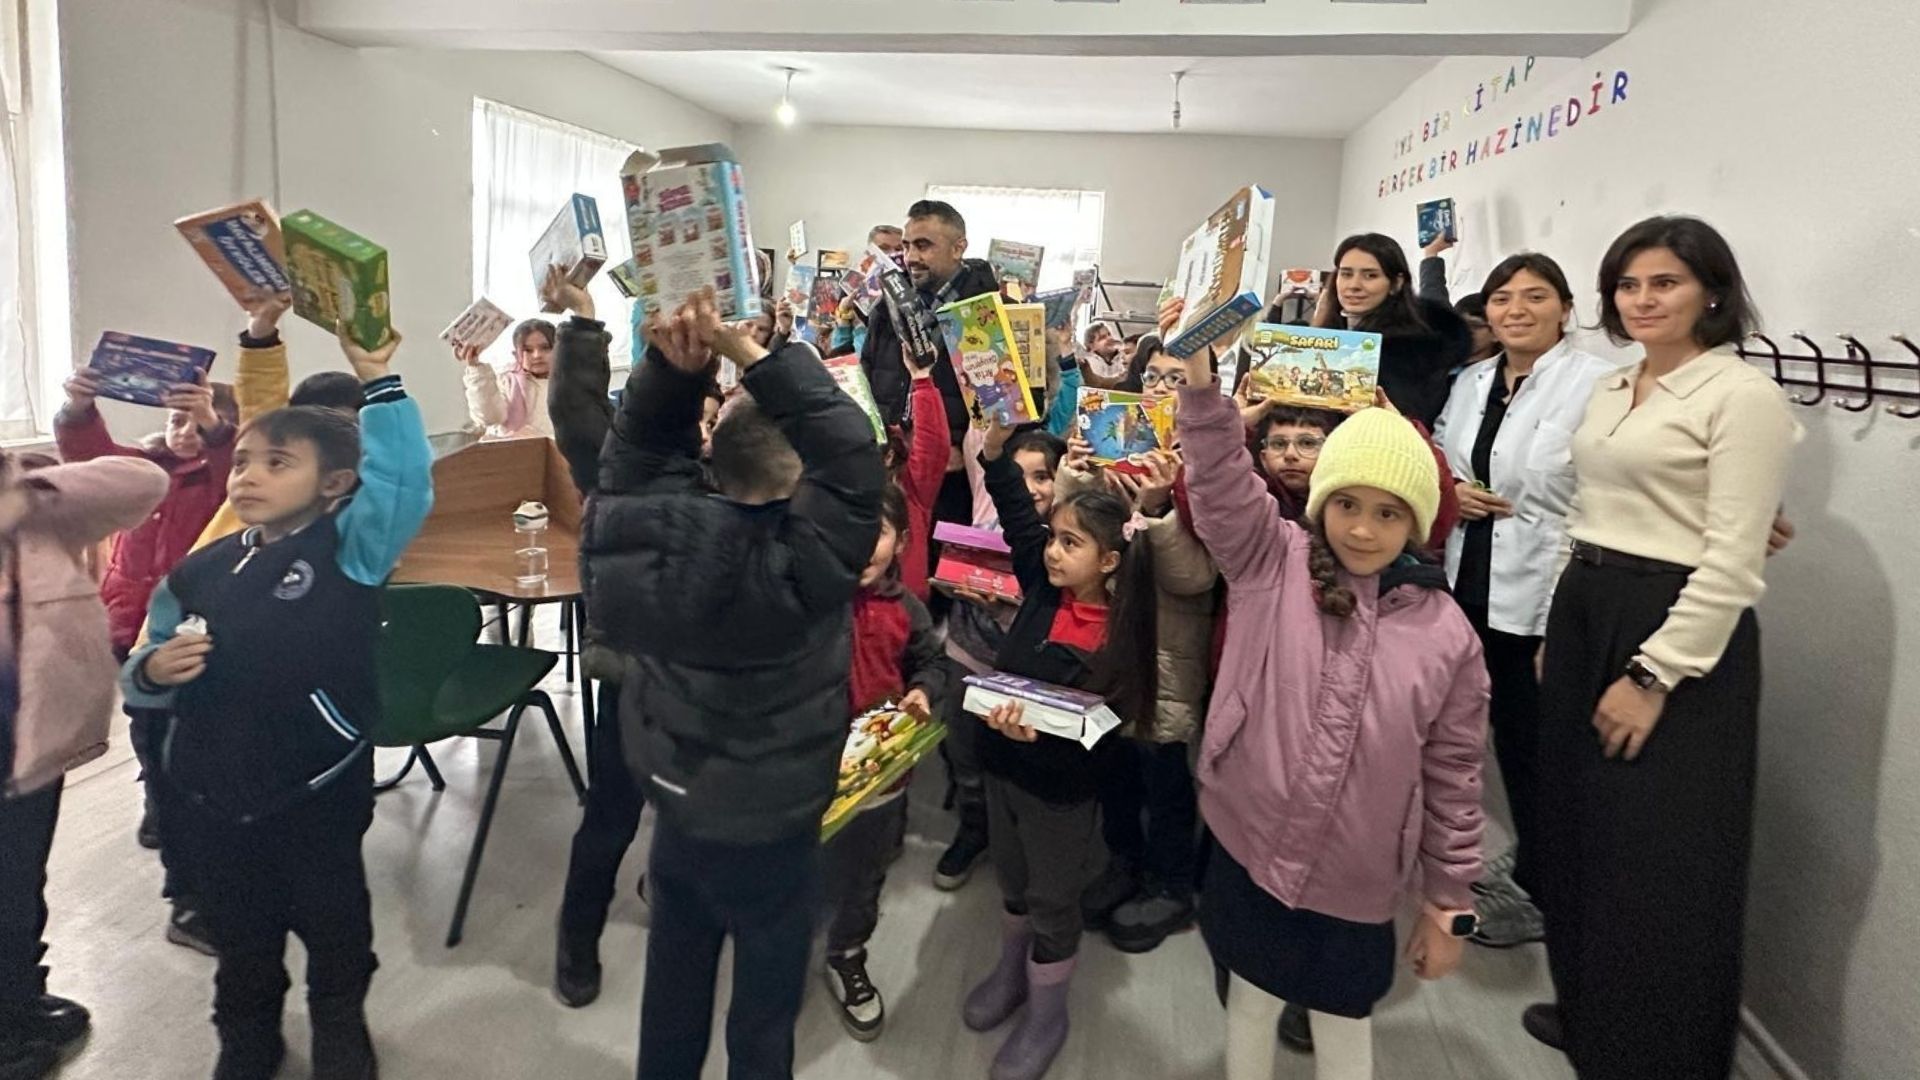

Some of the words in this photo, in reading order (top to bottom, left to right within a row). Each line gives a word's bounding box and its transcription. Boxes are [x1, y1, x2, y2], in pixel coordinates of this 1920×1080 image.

[1422, 111, 1451, 142] BİR
[1429, 150, 1458, 179] BİR
[1466, 71, 1628, 165] HAZİNEDİR
